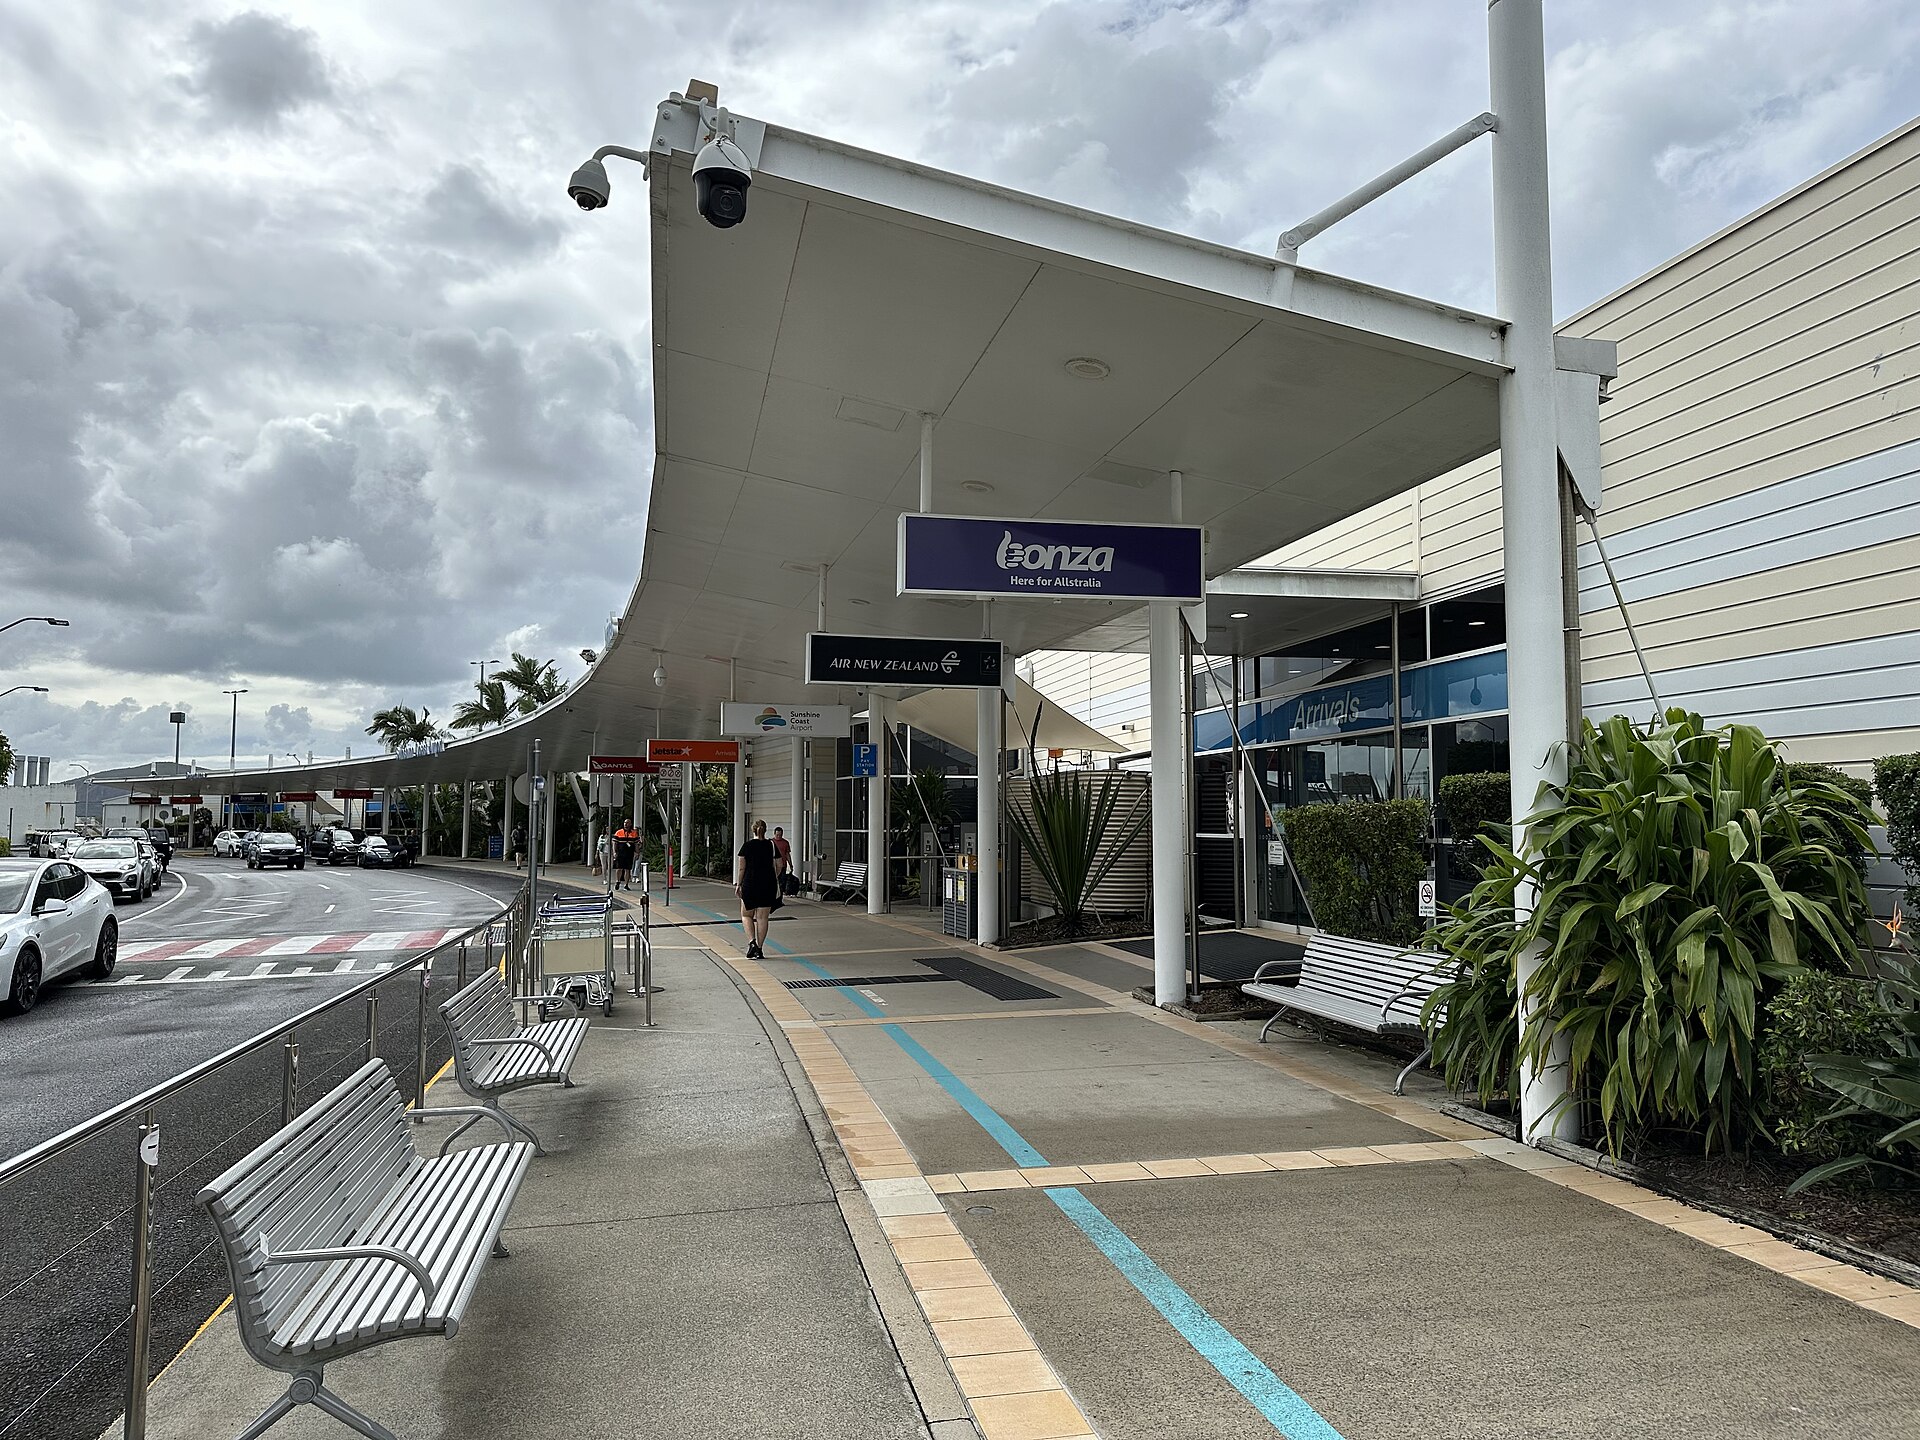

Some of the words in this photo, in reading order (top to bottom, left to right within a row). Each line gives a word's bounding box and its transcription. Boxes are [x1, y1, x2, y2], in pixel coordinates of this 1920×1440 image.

[996, 530, 1115, 572] bonza
[1010, 575, 1035, 587] Here
[1036, 575, 1052, 587] for
[1054, 576, 1101, 588] Allstralia
[829, 657, 851, 668] AIR
[853, 659, 882, 670] NEW
[884, 660, 939, 671] ZEALAND
[1293, 690, 1360, 729] Arrivals
[790, 724, 813, 732] Airport
[652, 747, 683, 756] Jetstar
[860, 746, 870, 758] P
